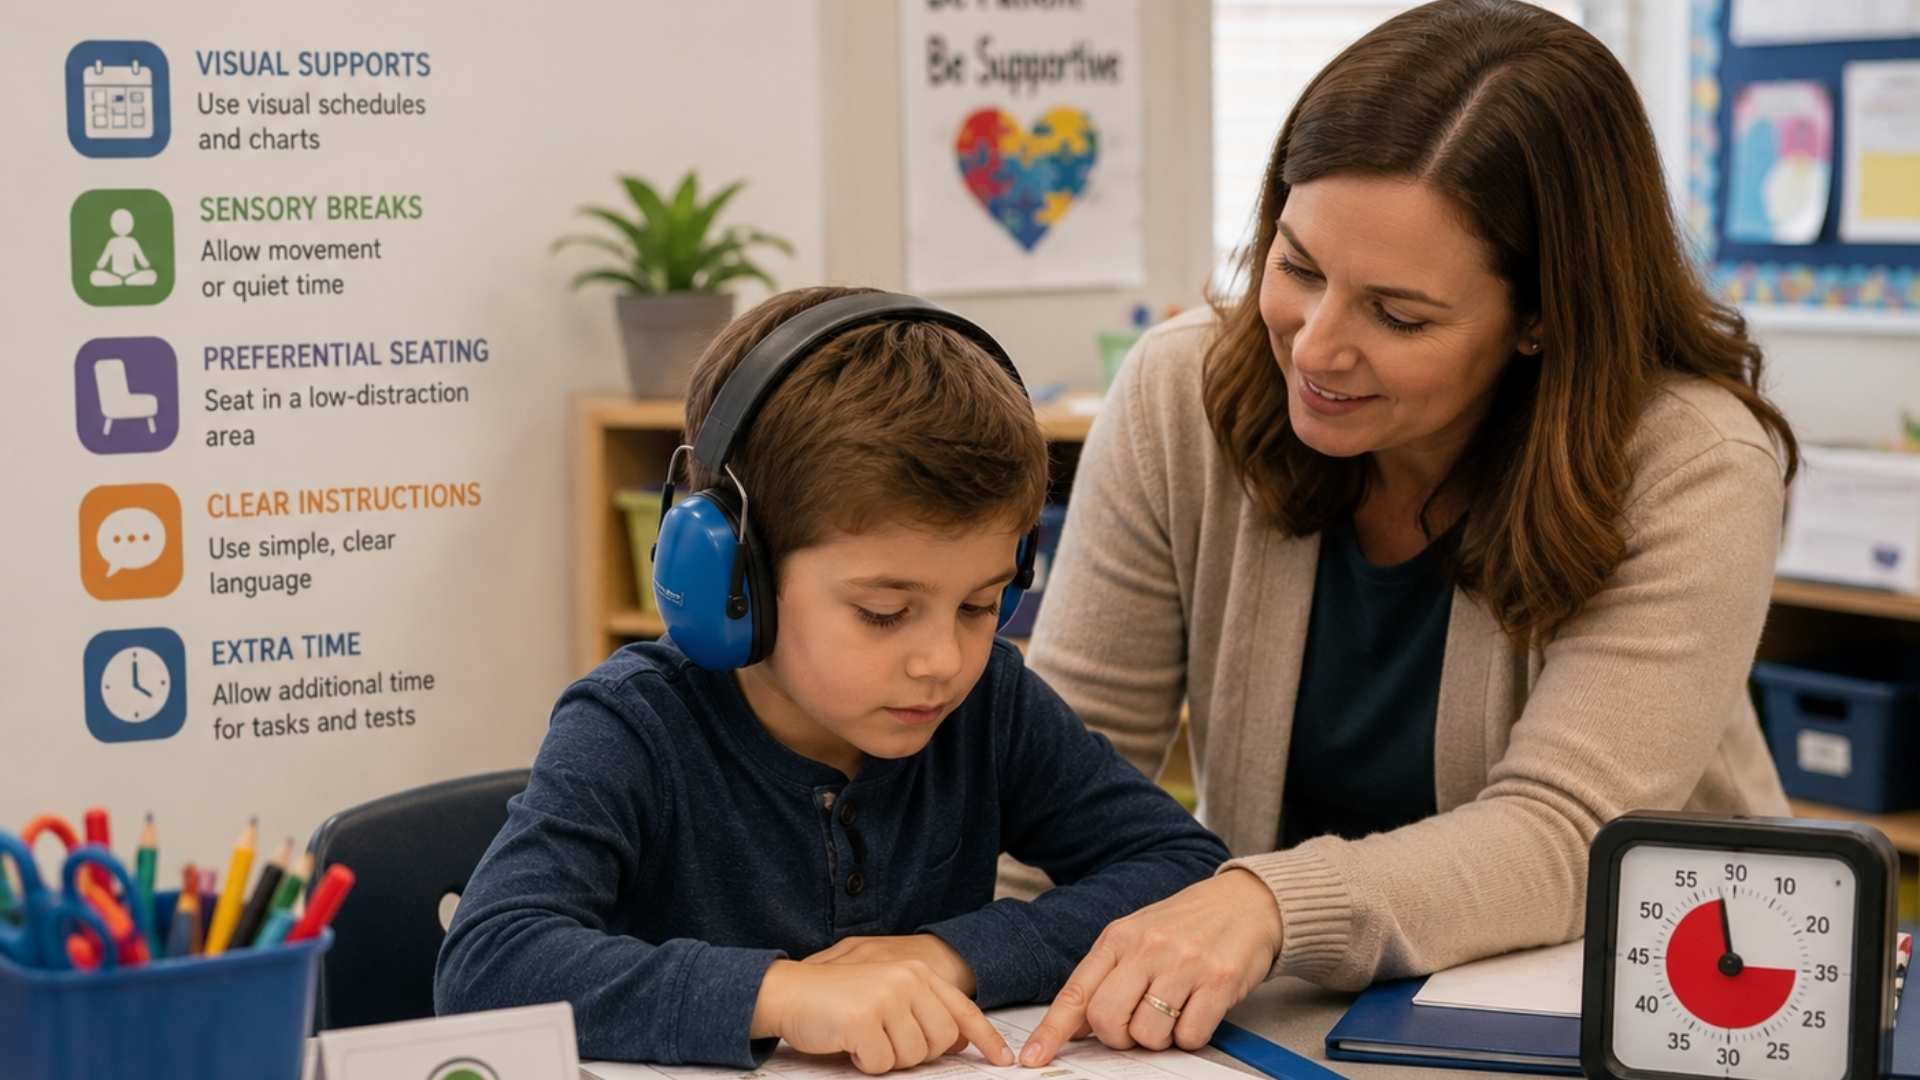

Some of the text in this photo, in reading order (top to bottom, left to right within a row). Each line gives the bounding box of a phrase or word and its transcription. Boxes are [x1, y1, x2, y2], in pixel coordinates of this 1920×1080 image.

[195, 50, 432, 78] VISUAL SUPPORTS
[926, 35, 1121, 94] Be Supportive
[197, 91, 427, 116] Use visual schedules
[198, 126, 321, 151] and charts
[199, 194, 423, 223] SENSORY BREAKS
[200, 238, 382, 262] Allow movement
[201, 273, 345, 303] or quiet time
[203, 337, 489, 372] PREFERENTIAL SEATING
[204, 381, 470, 412] Seat in a low-distraction
[205, 428, 255, 448] area
[207, 480, 482, 519] CLEAR INSTRUCTIONS
[208, 529, 397, 561] Use simple, clear
[210, 571, 312, 599] language
[211, 631, 362, 667] EXTRA TIME
[212, 670, 436, 706] Allow additional time
[213, 706, 416, 741] for tasks and tests
[1674, 869, 1698, 889] 55
[1774, 876, 1796, 896] 10
[1639, 901, 1664, 920] 50
[1805, 915, 1830, 935] 20
[1626, 947, 1650, 966] 45
[1634, 994, 1659, 1014] 40
[1801, 1010, 1827, 1029] 25
[1667, 1031, 1691, 1051] 35
[1765, 1041, 1790, 1061] 25
[1716, 1047, 1741, 1067] 30
